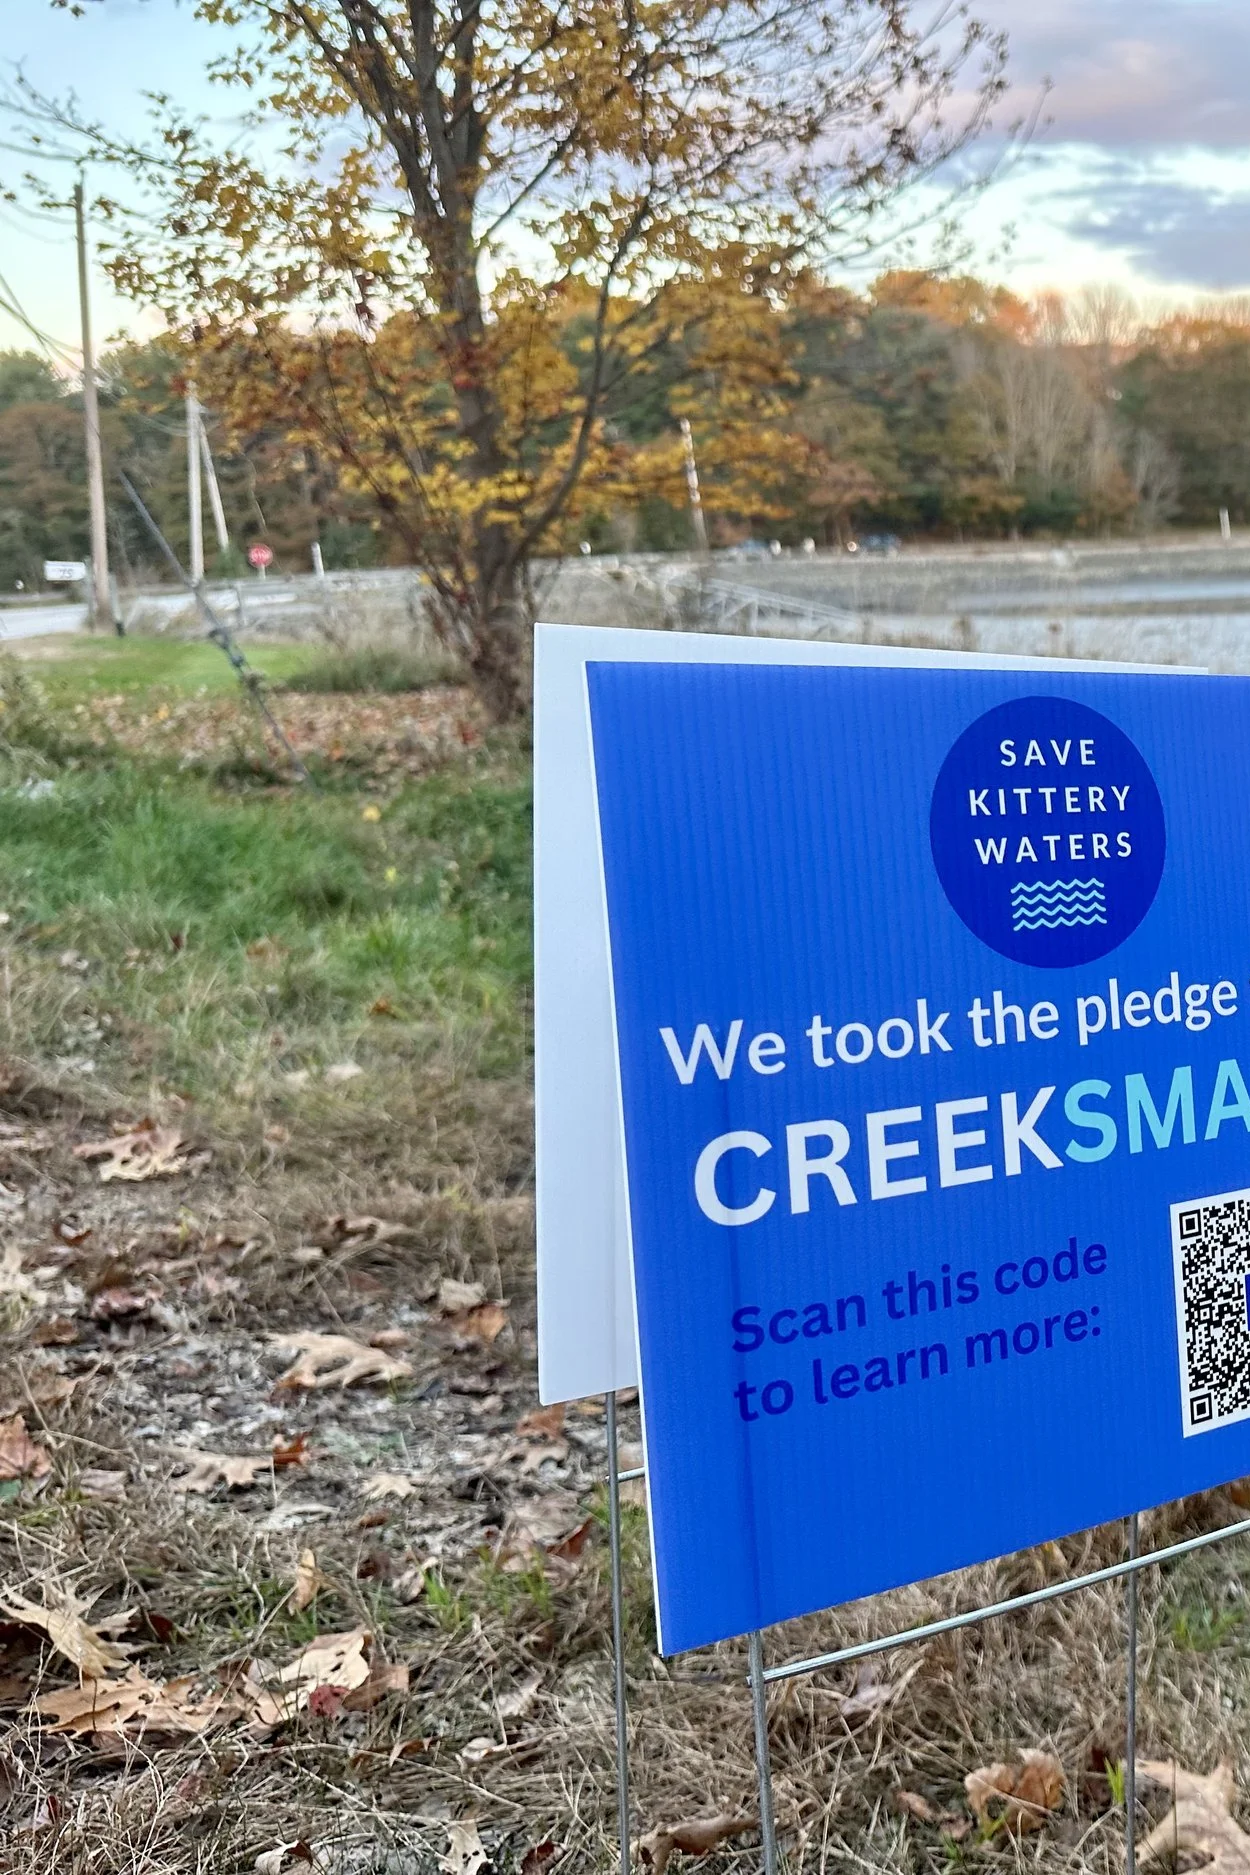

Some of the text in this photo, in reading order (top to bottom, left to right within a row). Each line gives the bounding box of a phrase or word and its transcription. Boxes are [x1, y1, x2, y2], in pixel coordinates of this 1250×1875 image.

[999, 739, 1096, 767] SAVE
[969, 785, 1130, 816] KITTERY
[974, 832, 1133, 865] WATERS
[659, 1019, 786, 1085] We
[805, 998, 953, 1068] took
[967, 990, 1060, 1047] the
[1076, 971, 1238, 1046] pledge
[730, 1236, 1108, 1353] Scan this code
[733, 1305, 1101, 1423] to learn more:
